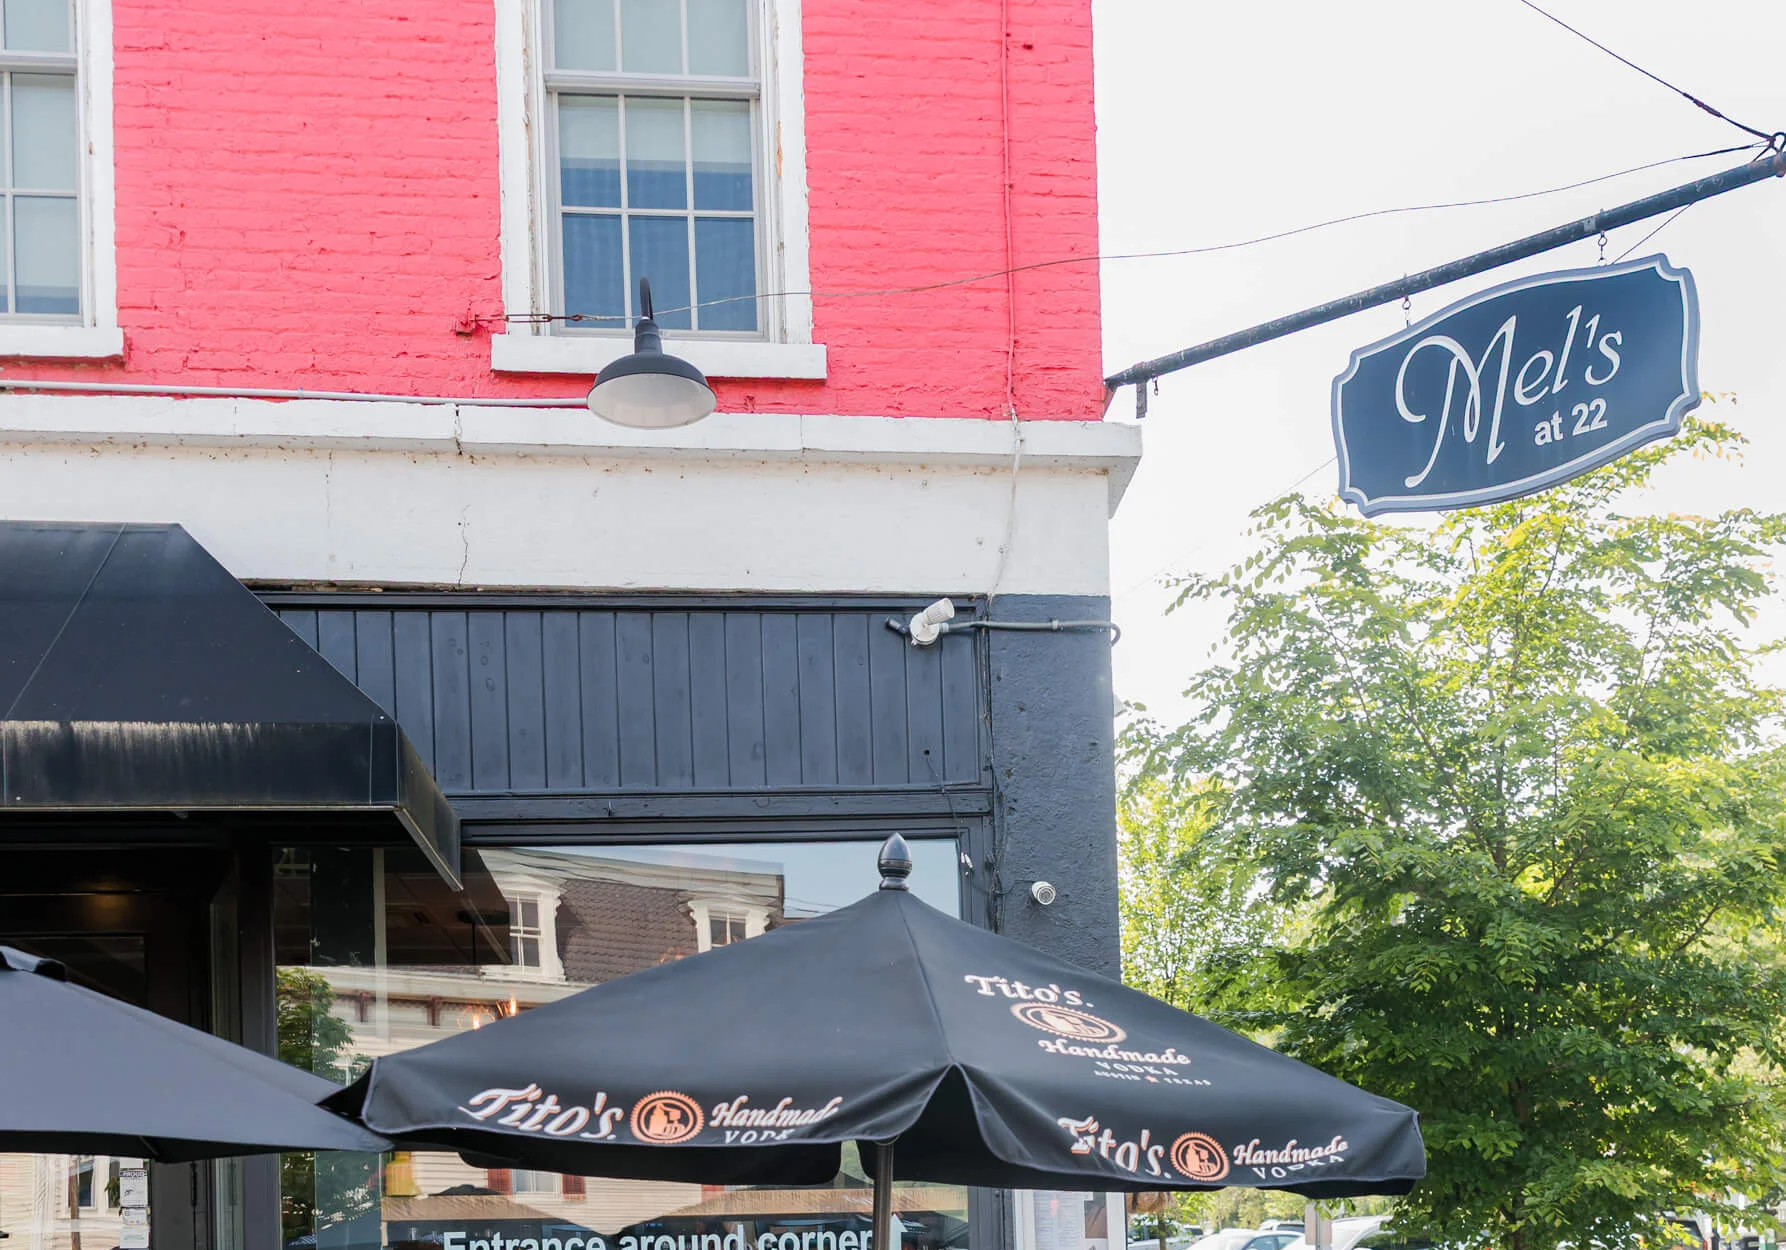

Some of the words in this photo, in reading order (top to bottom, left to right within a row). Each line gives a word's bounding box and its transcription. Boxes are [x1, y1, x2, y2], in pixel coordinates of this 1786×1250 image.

[1395, 305, 1624, 489] Mel's
[1534, 412, 1564, 447] at
[1573, 398, 1609, 436] 22
[1038, 1039, 1192, 1066] Handmade
